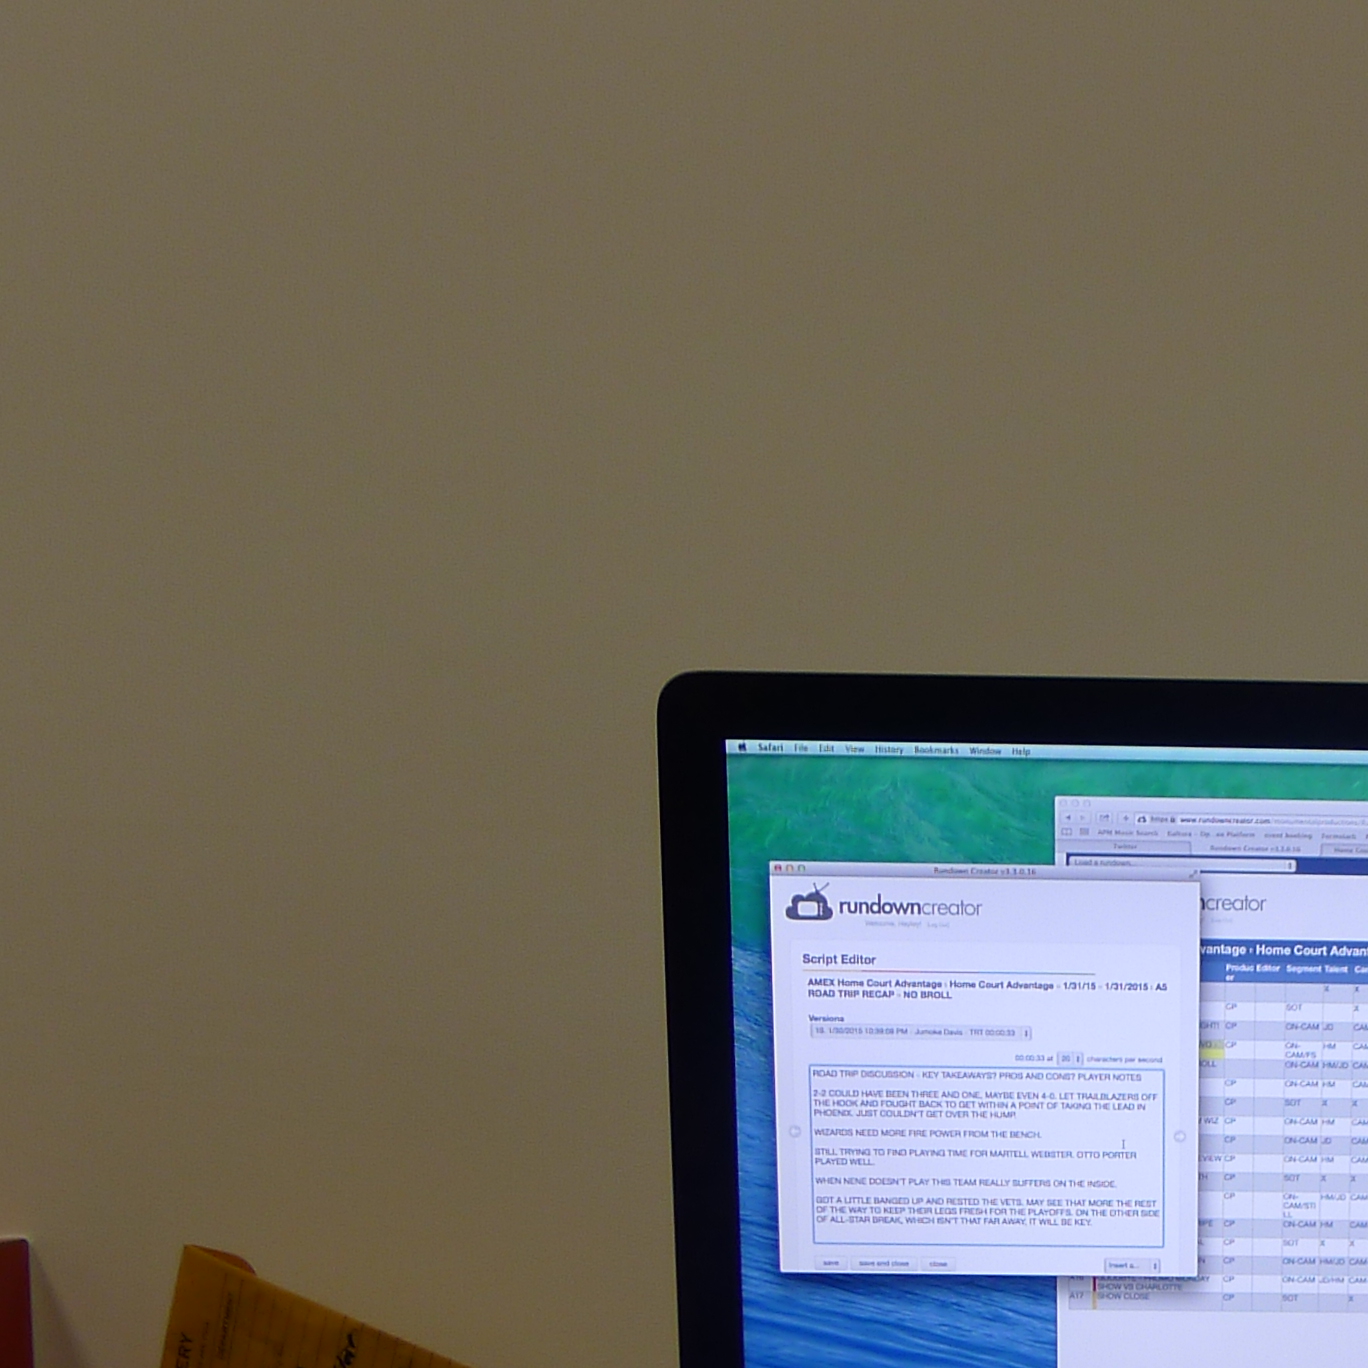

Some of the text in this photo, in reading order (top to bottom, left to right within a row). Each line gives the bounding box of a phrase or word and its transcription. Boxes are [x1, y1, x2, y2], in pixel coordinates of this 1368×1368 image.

[758, 743, 785, 753] Safari
[875, 745, 905, 755] History
[915, 745, 960, 756] Bookmarks
[969, 746, 1002, 756] Window
[1012, 746, 1032, 757] Help
[839, 894, 983, 916] rundowncreator
[1255, 945, 1291, 957] Home
[1293, 945, 1327, 957] Court
[802, 954, 877, 966] Script Editor
[1256, 964, 1281, 974] Editor
[1286, 964, 1321, 974] Segment
[1325, 965, 1348, 975] Talent
[808, 978, 836, 988] AMEX
[837, 979, 865, 988] Home
[866, 979, 893, 989] Court
[894, 980, 943, 989] Advantage
[949, 980, 977, 990] Home
[978, 981, 1004, 990] Court
[1006, 981, 1055, 991] Advantage
[1062, 982, 1097, 992] 1/31/15
[1155, 983, 1168, 992] A5
[808, 990, 952, 1000] ROAD TRIP RECAP NO BROLL
[808, 1014, 845, 1023] Versions
[813, 1069, 838, 1079] ROAD
[921, 1071, 940, 1080] KEY
[1077, 1073, 1111, 1082] PLAYER
[880, 1129, 907, 1138] MORE
[963, 1130, 989, 1139] FROM
[990, 1130, 1008, 1139] THE
[947, 1149, 968, 1158] TIME
[953, 1178, 977, 1187] TEAM
[1068, 1179, 1086, 1188] THE
